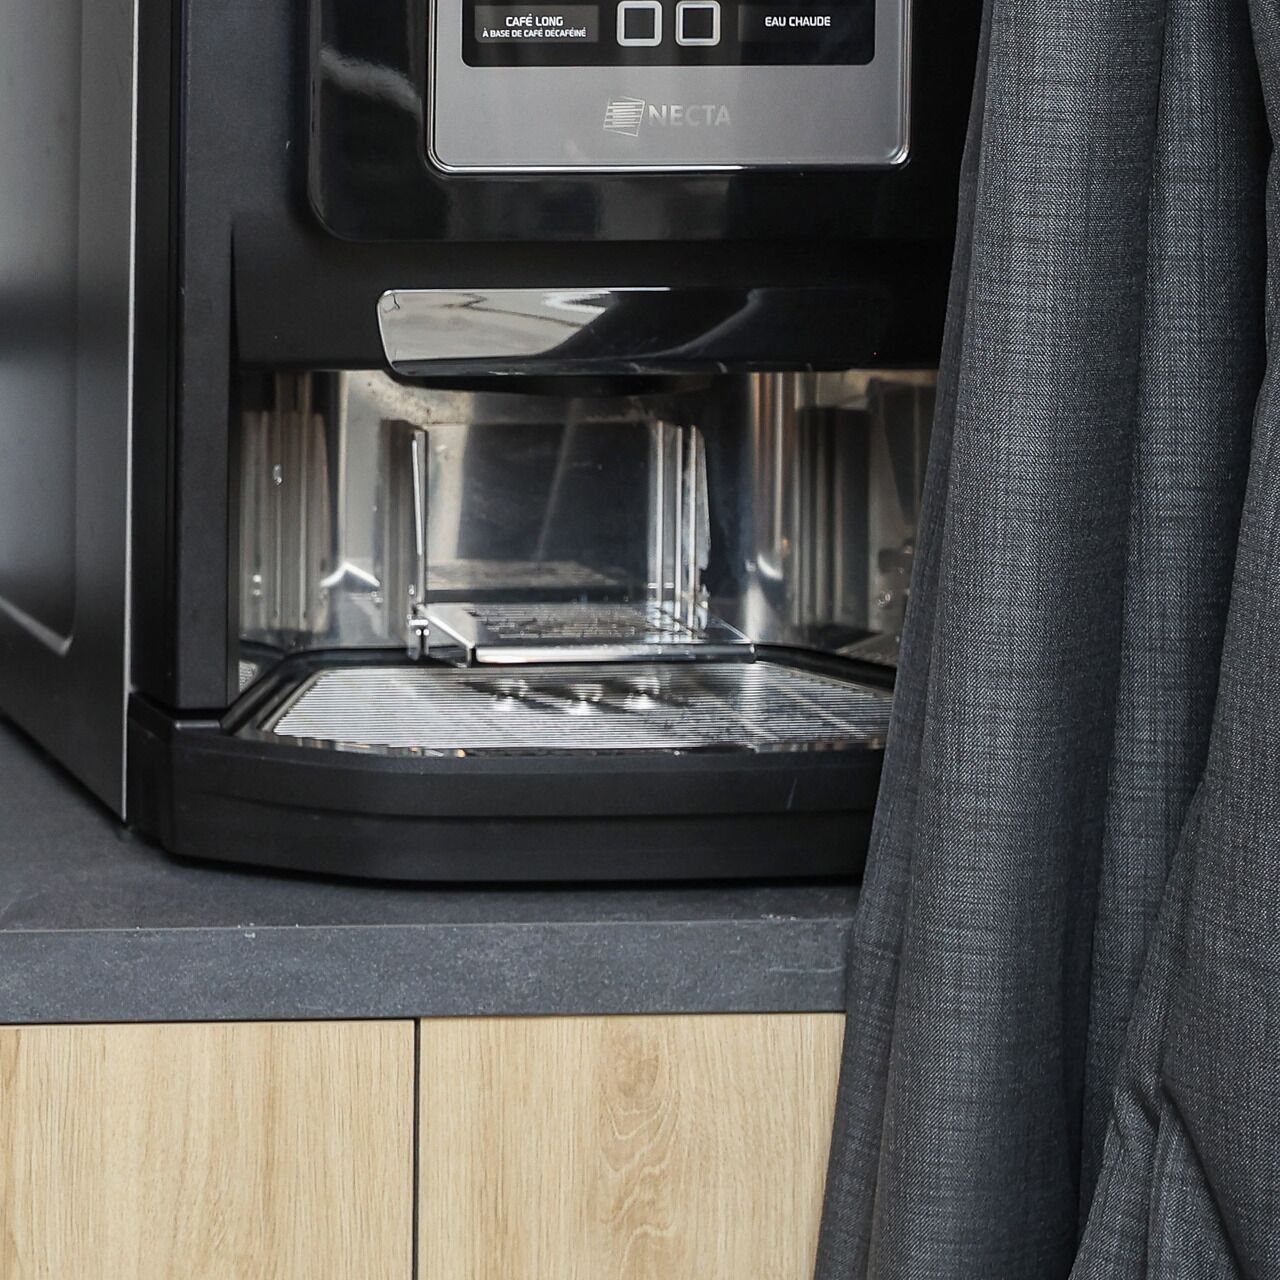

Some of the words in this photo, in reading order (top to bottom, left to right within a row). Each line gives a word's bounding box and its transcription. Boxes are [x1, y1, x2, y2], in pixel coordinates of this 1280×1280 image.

[506, 14, 532, 26] CAFÉ
[536, 16, 563, 26] LONG
[765, 16, 786, 26] EAU
[789, 16, 831, 26] CHAUDE
[490, 30, 510, 38] BASE
[512, 30, 522, 38] DE
[524, 28, 543, 38] CAFÉ
[545, 27, 586, 38] DÉCAFÉINÉ
[648, 104, 731, 127] NECTA
